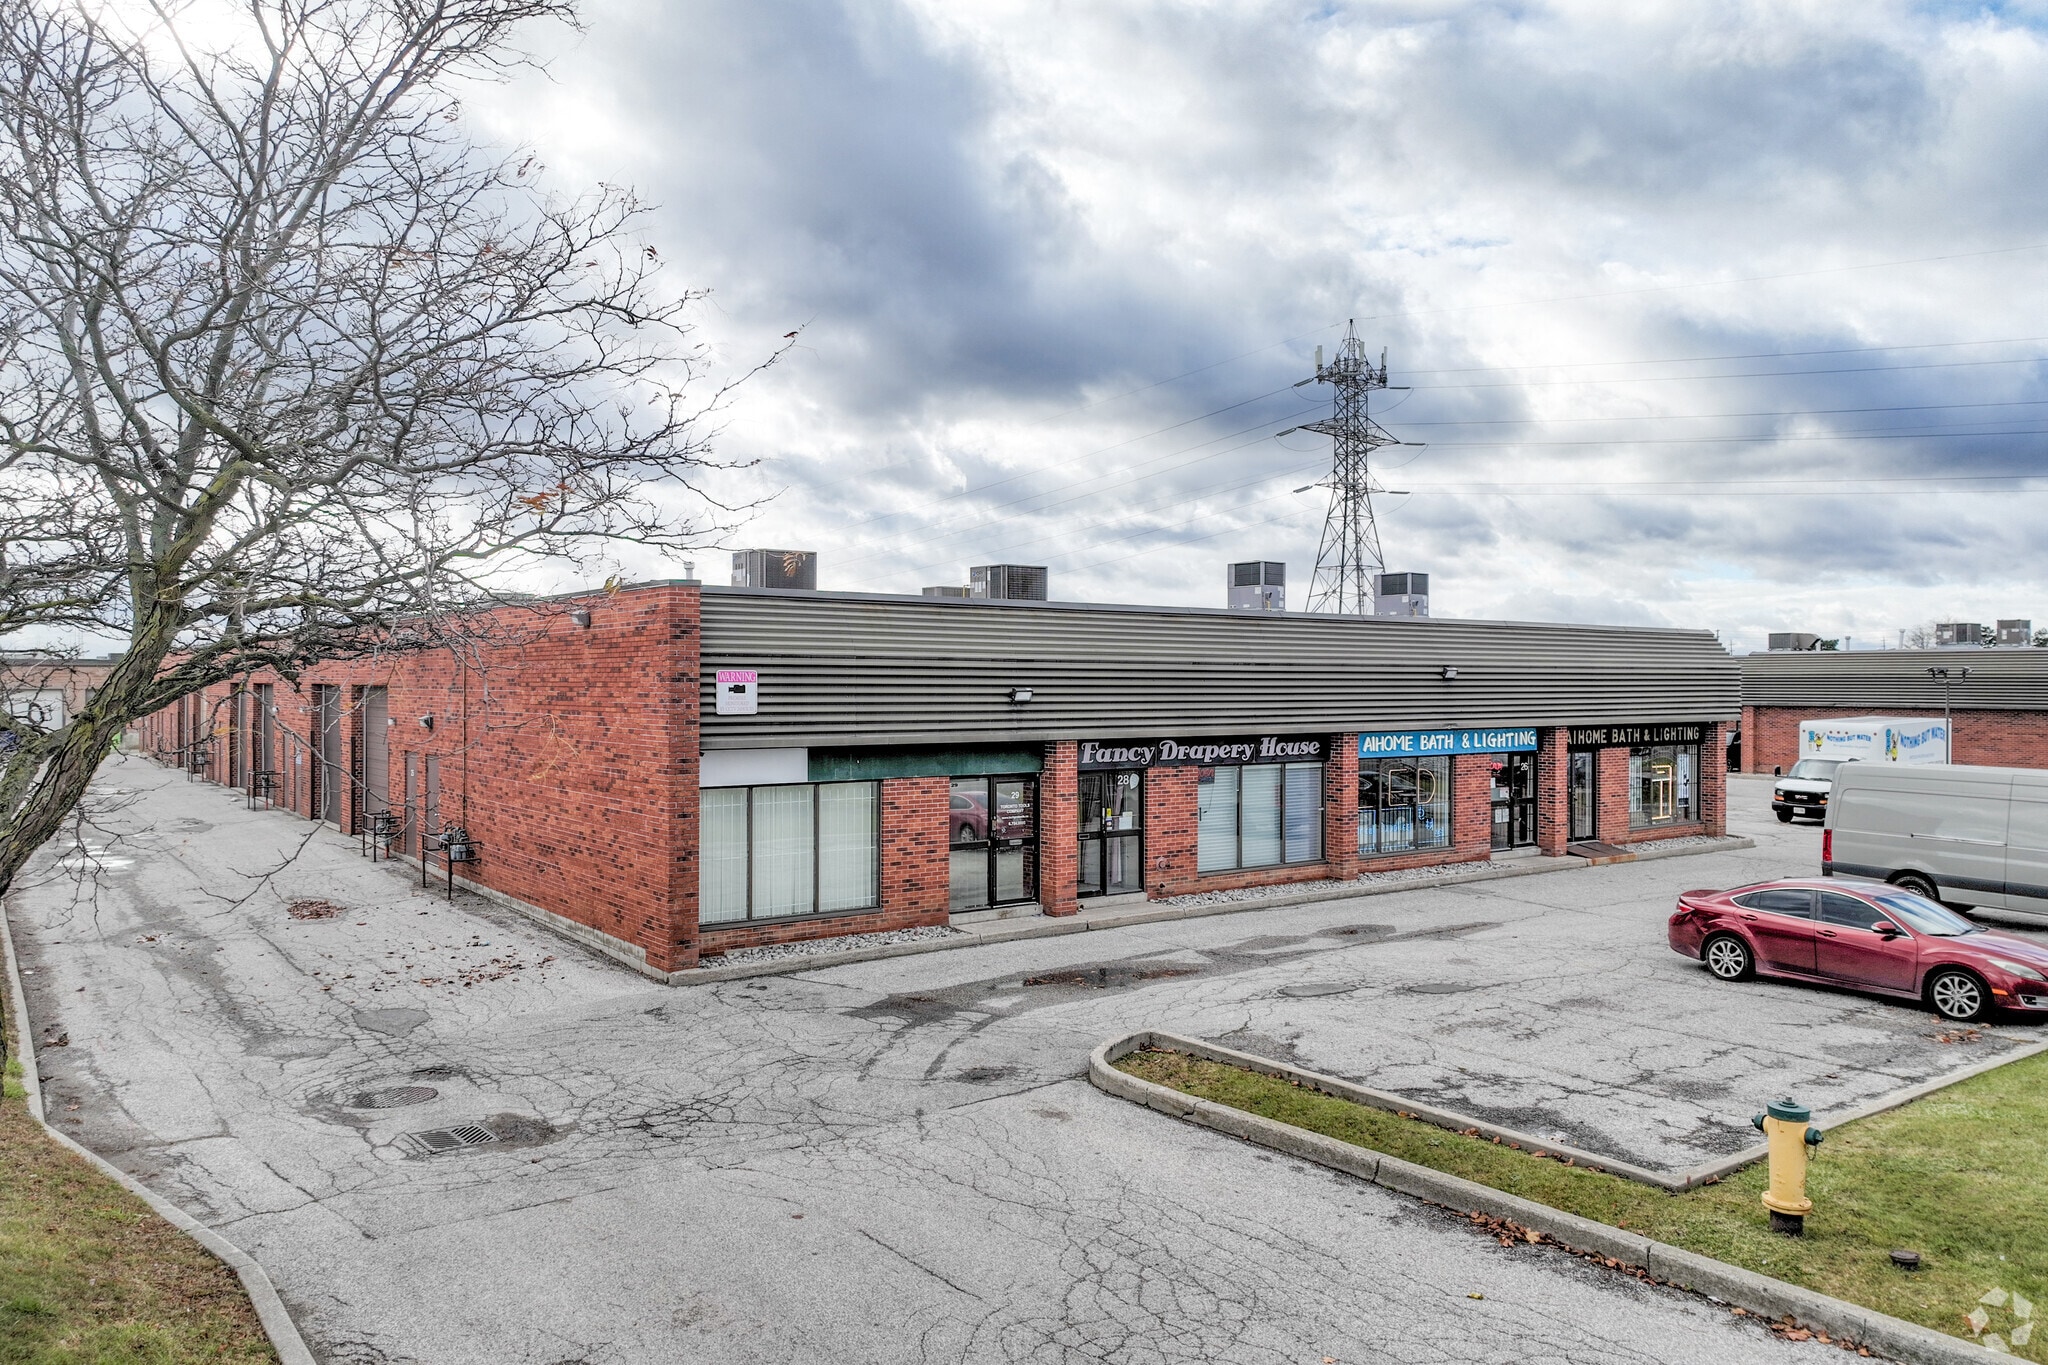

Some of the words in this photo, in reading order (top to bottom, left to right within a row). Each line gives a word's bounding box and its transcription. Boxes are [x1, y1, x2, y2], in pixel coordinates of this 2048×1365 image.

[719, 671, 756, 682] WARNING
[1362, 735, 1413, 753] AIHOME
[1420, 733, 1454, 751] BATH
[1461, 732, 1470, 749] &
[1473, 730, 1537, 748] LIGHTING
[1567, 729, 1607, 745] AIHOME
[1612, 728, 1640, 743] BATH
[1643, 729, 1650, 742] &
[1653, 726, 1700, 742] LIGHTING
[1857, 734, 1871, 742] WATER
[1921, 728, 1930, 744] BUT
[1931, 727, 1946, 742] WATER
[1081, 742, 1156, 765] Fancy
[1159, 740, 1254, 763] Drapery
[1260, 737, 1320, 758] House
[1520, 762, 1529, 771] 26
[1117, 774, 1130, 785] 28
